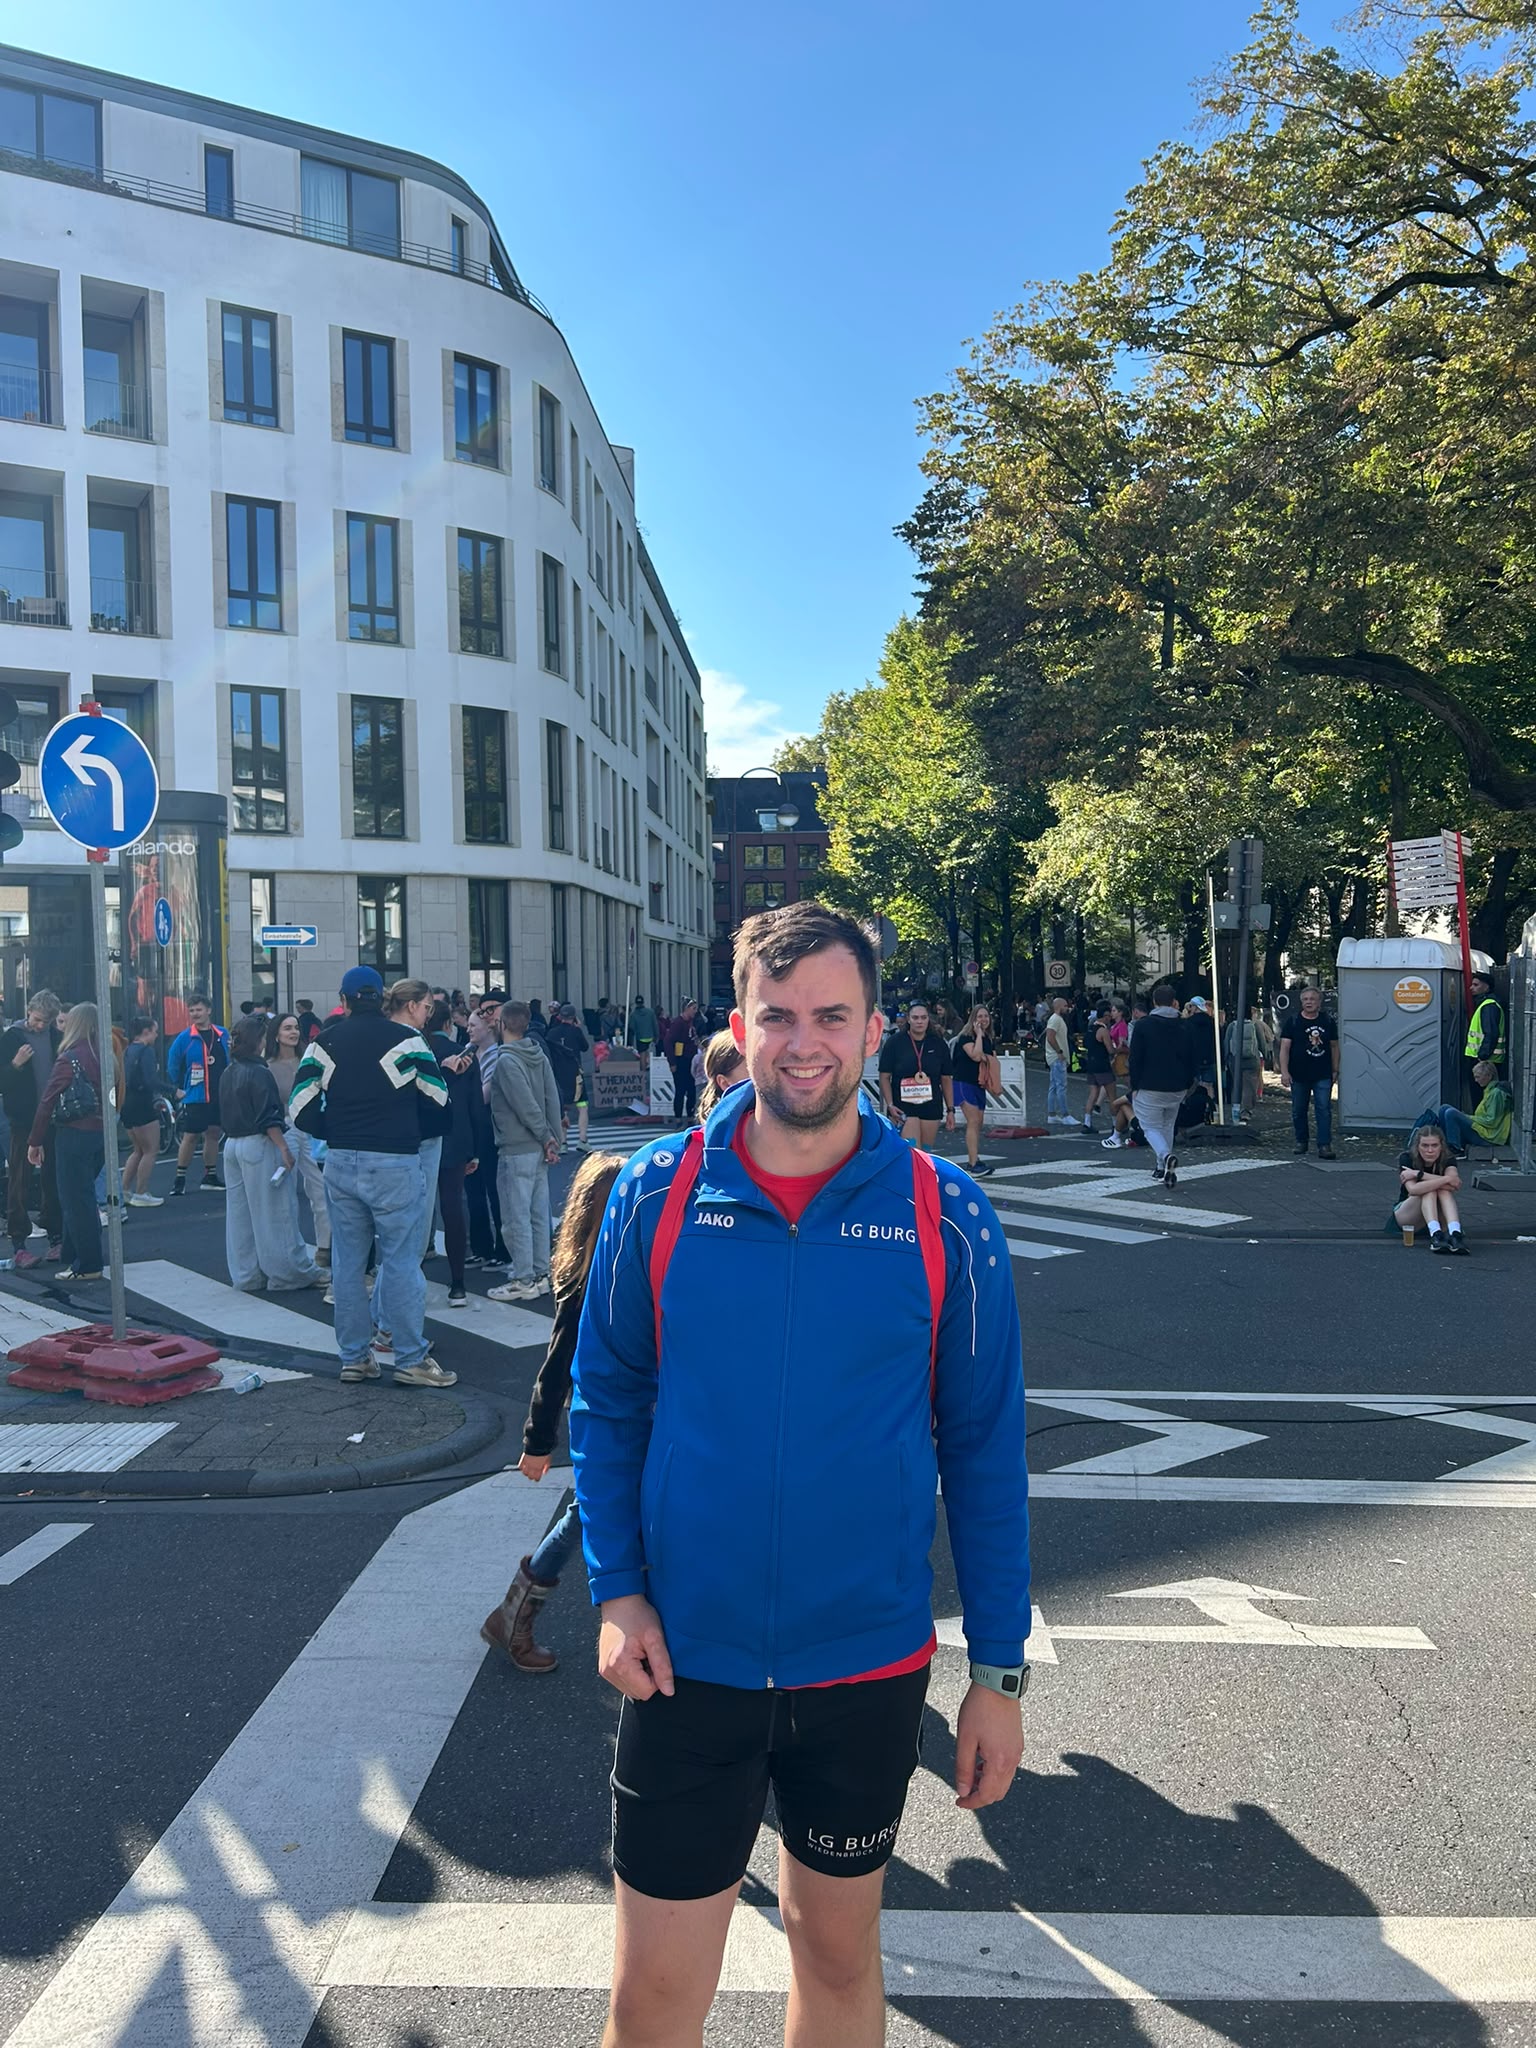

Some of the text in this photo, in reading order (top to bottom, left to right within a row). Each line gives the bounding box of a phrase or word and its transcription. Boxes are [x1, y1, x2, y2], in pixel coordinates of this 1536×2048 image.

[126, 840, 196, 856] zalando
[1053, 967, 1063, 976] 30
[595, 1075, 643, 1086] THERAPY
[598, 1085, 642, 1095] WAS ALSO
[695, 1212, 734, 1228] JAKO
[840, 1222, 916, 1243] LG BURG
[808, 1827, 834, 1849] LG
[845, 1816, 899, 1850] BURG
[807, 1841, 873, 1858] WIEDENBRÜCK
